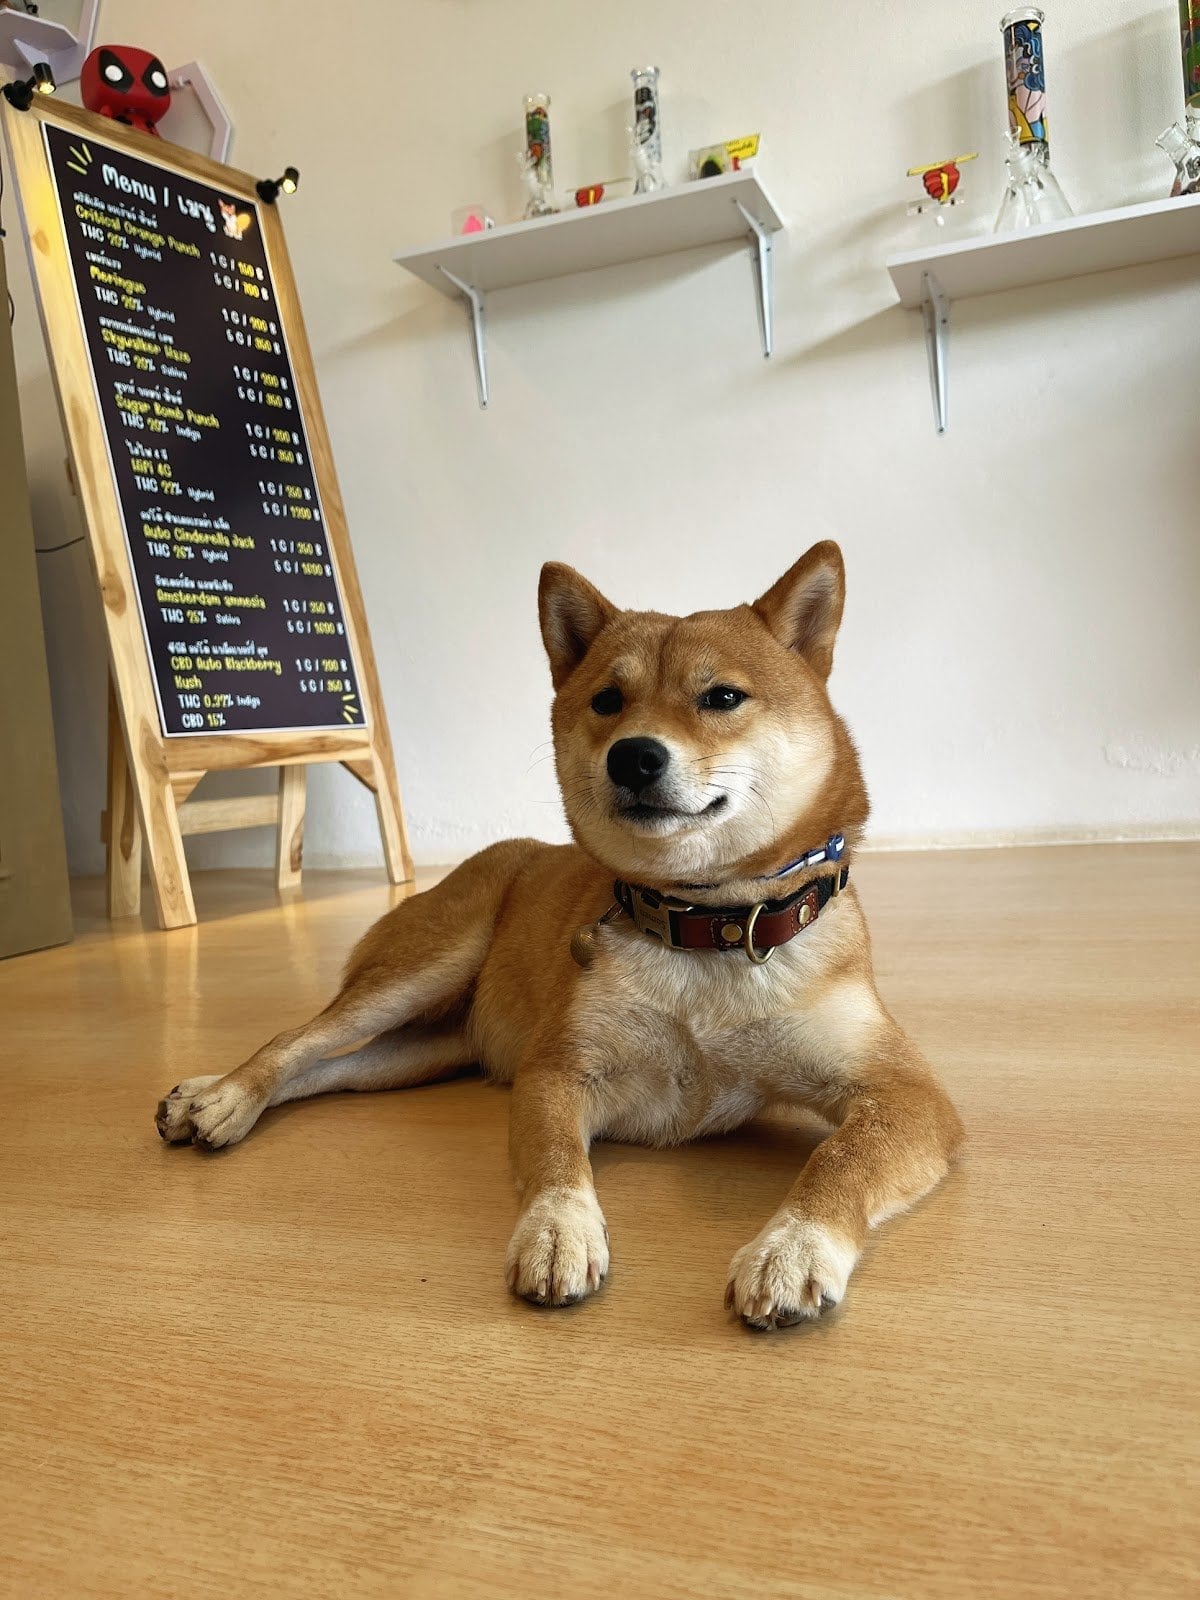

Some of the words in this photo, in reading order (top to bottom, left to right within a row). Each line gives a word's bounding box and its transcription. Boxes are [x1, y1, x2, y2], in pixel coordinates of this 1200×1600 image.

[102, 164, 157, 205] Menu
[164, 187, 169, 207] /
[177, 195, 216, 233] เมนู
[75, 204, 121, 230] Critical
[124, 221, 166, 248] Orange
[167, 236, 200, 257] Punch
[80, 222, 104, 242] THC
[134, 243, 162, 262] Hybrid
[210, 252, 217, 265] 1
[218, 255, 228, 269] G
[230, 259, 235, 271] /
[90, 265, 146, 295] Meringue
[214, 272, 222, 286] 5
[223, 275, 232, 289] G
[235, 279, 240, 291] /
[94, 285, 118, 305] THC
[222, 308, 229, 322] 1
[230, 310, 240, 325] G
[242, 314, 247, 326] /
[101, 328, 161, 354] Skywalker
[164, 345, 191, 363] Haze
[226, 329, 234, 342] 5
[235, 331, 244, 345] G
[247, 334, 252, 347] /
[107, 347, 131, 366] THC
[233, 365, 240, 379] 1
[242, 367, 251, 381] G
[254, 370, 258, 383] /
[237, 386, 245, 399] 5
[247, 388, 256, 402] G
[258, 390, 263, 403] /
[115, 393, 151, 416] Sugar
[153, 402, 184, 420] Bomb
[186, 409, 220, 428] Punch
[120, 411, 144, 429] THC
[245, 423, 252, 436] 1
[254, 424, 263, 438] G
[265, 427, 270, 439] /
[249, 444, 257, 457] 5
[259, 445, 268, 459] G
[270, 447, 275, 460] /
[157, 463, 172, 478] 4G
[135, 475, 158, 493] THC
[187, 487, 215, 502] Hybrid
[259, 481, 266, 494] 1
[267, 482, 276, 495] G
[278, 483, 283, 496] /
[262, 501, 270, 514] 5
[271, 502, 280, 516] G
[283, 504, 287, 517] /
[143, 524, 171, 540] Auto
[174, 527, 230, 547] Cinderella
[232, 534, 255, 549] Jack
[147, 541, 170, 558] THC
[201, 549, 229, 563] Hybrid
[270, 539, 277, 552] 1
[278, 539, 287, 553] G
[290, 540, 294, 553] /
[274, 559, 282, 572] 5
[283, 560, 292, 573] G
[294, 561, 299, 574] /
[156, 588, 221, 606] Amsterdam
[223, 596, 266, 609] amnesia
[283, 599, 290, 612] 1
[291, 599, 300, 613] G
[302, 600, 307, 613] /
[161, 608, 184, 623] THC
[215, 613, 241, 625] Sativa
[287, 620, 294, 633] 5
[296, 620, 304, 633] G
[307, 621, 311, 633] /
[171, 656, 193, 670] CBD
[196, 657, 222, 671] Auto
[225, 657, 282, 675] Blackberry
[295, 659, 302, 672] 1
[304, 658, 312, 672] G
[315, 659, 319, 672] /
[174, 675, 202, 690] Kush
[300, 680, 307, 692] 5
[309, 679, 317, 692] G
[319, 679, 324, 692] /
[178, 694, 201, 708] THC
[182, 713, 204, 728] CBD
[207, 713, 226, 727] 15%
